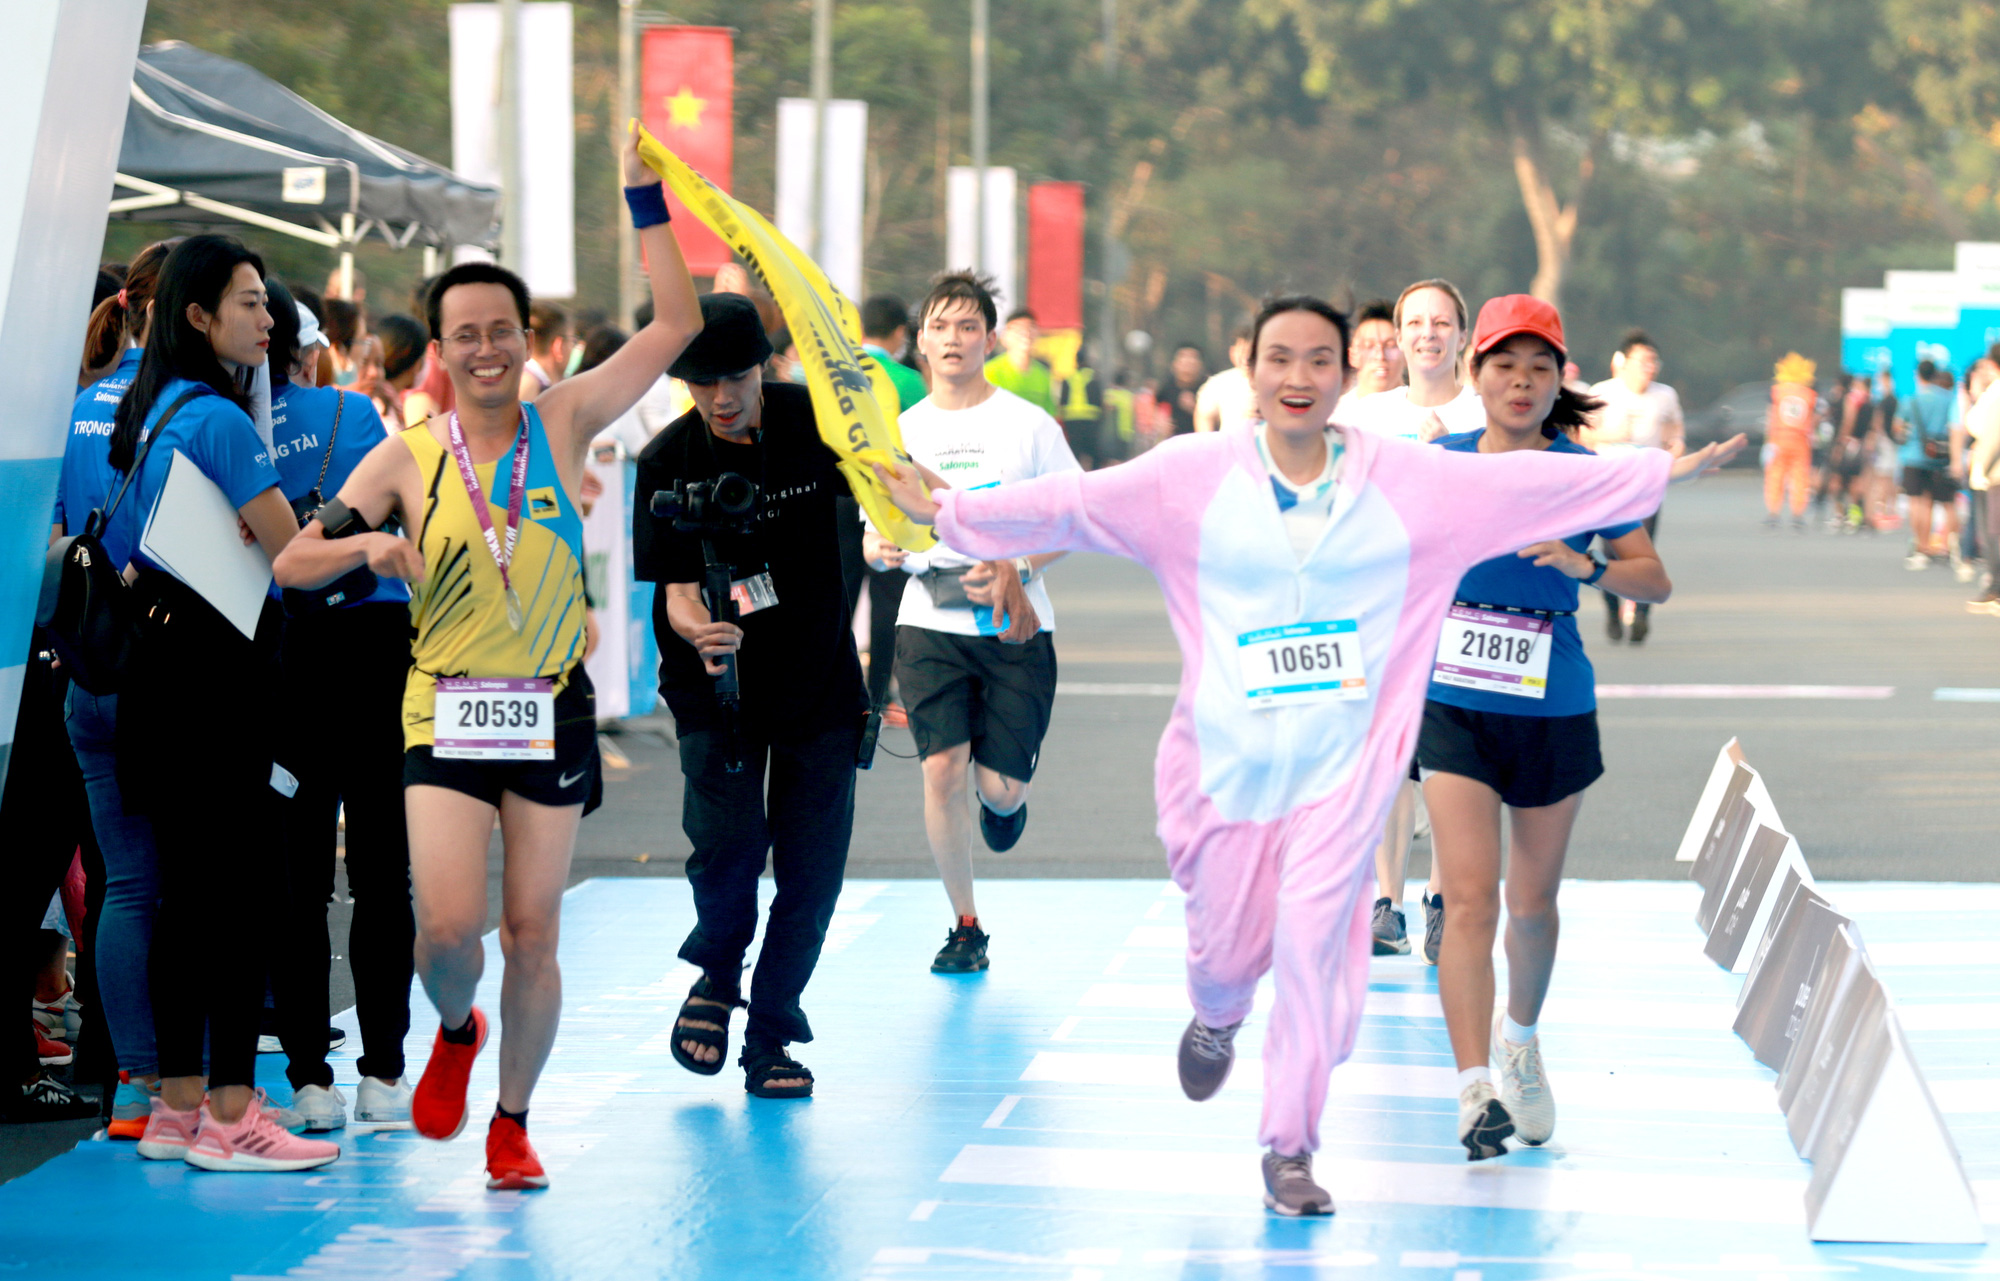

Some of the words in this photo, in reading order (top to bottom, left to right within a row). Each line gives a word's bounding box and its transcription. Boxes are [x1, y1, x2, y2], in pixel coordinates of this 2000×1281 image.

[291, 433, 319, 453] TÀI
[1267, 641, 1343, 674] 10651
[1460, 629, 1531, 665] 21818
[458, 700, 539, 728] 20539
